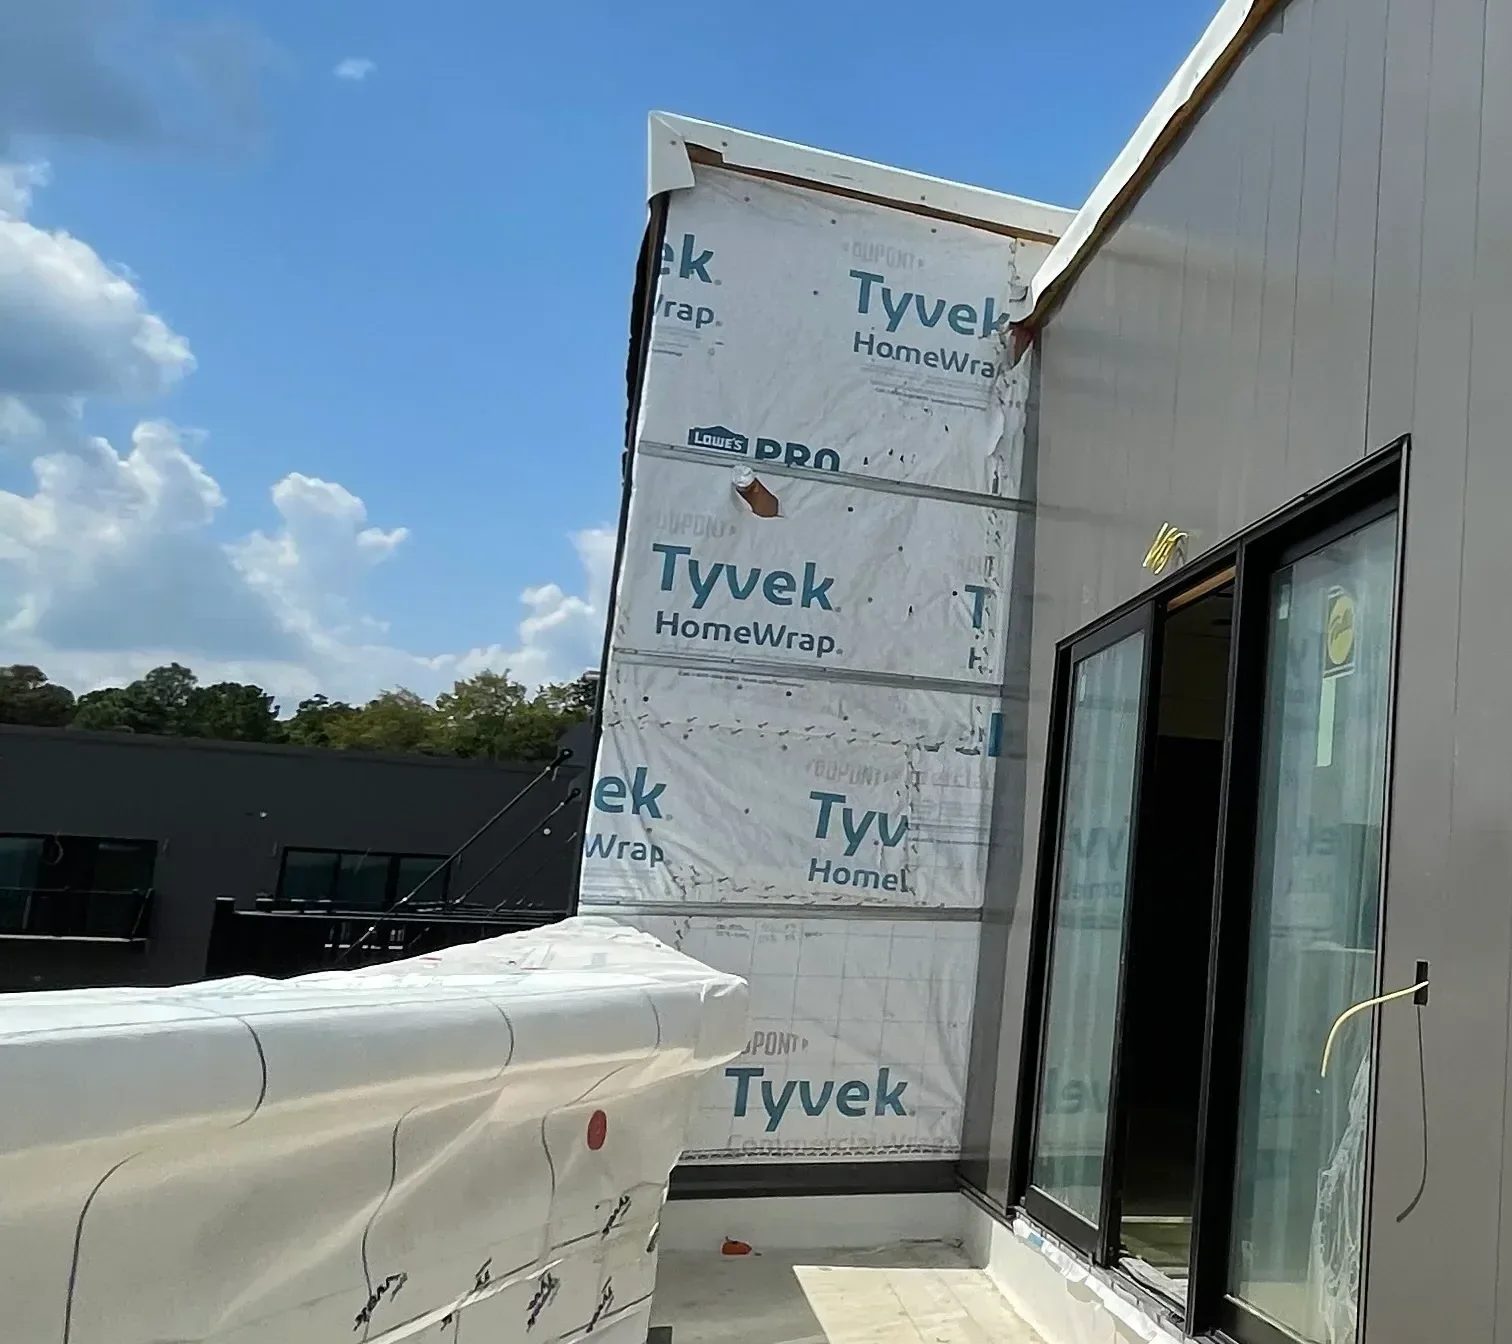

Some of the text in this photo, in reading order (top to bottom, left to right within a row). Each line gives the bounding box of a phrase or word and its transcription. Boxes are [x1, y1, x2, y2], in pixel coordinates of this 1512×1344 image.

[656, 294, 715, 329] rap
[850, 269, 1010, 336] Tyvek
[653, 543, 835, 611] Tyvek
[656, 611, 836, 658] HomeWrap
[594, 766, 667, 819] ek
[725, 1067, 909, 1132] Tyvek
